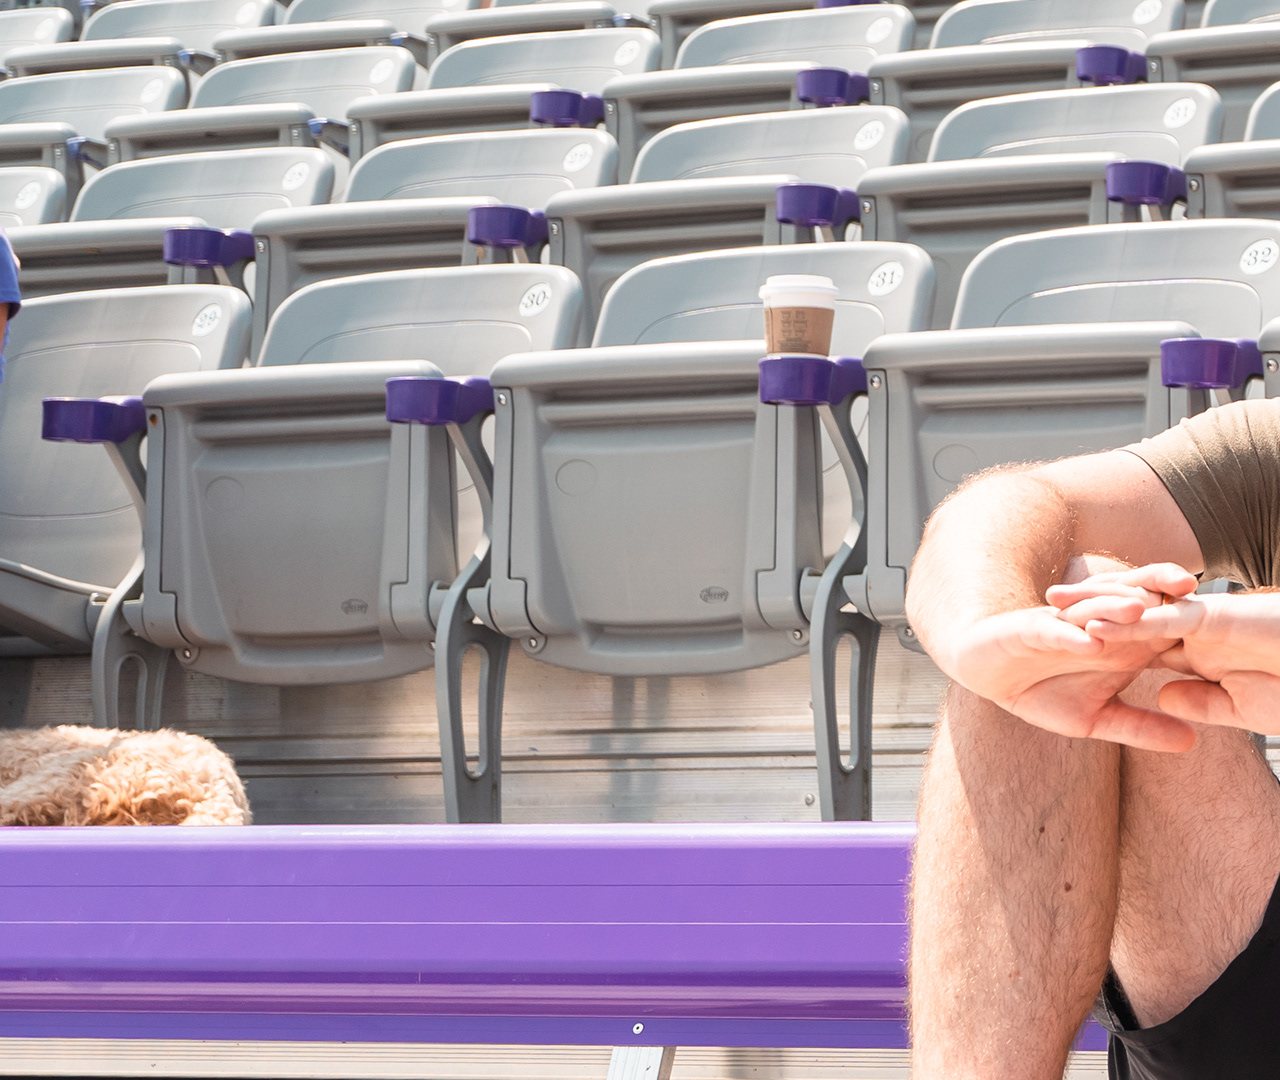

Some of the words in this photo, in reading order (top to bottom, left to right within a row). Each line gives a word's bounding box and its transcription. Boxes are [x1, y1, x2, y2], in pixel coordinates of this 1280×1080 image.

[1247, 247, 1272, 266] 32
[876, 269, 895, 287] 31
[525, 290, 547, 308] 30
